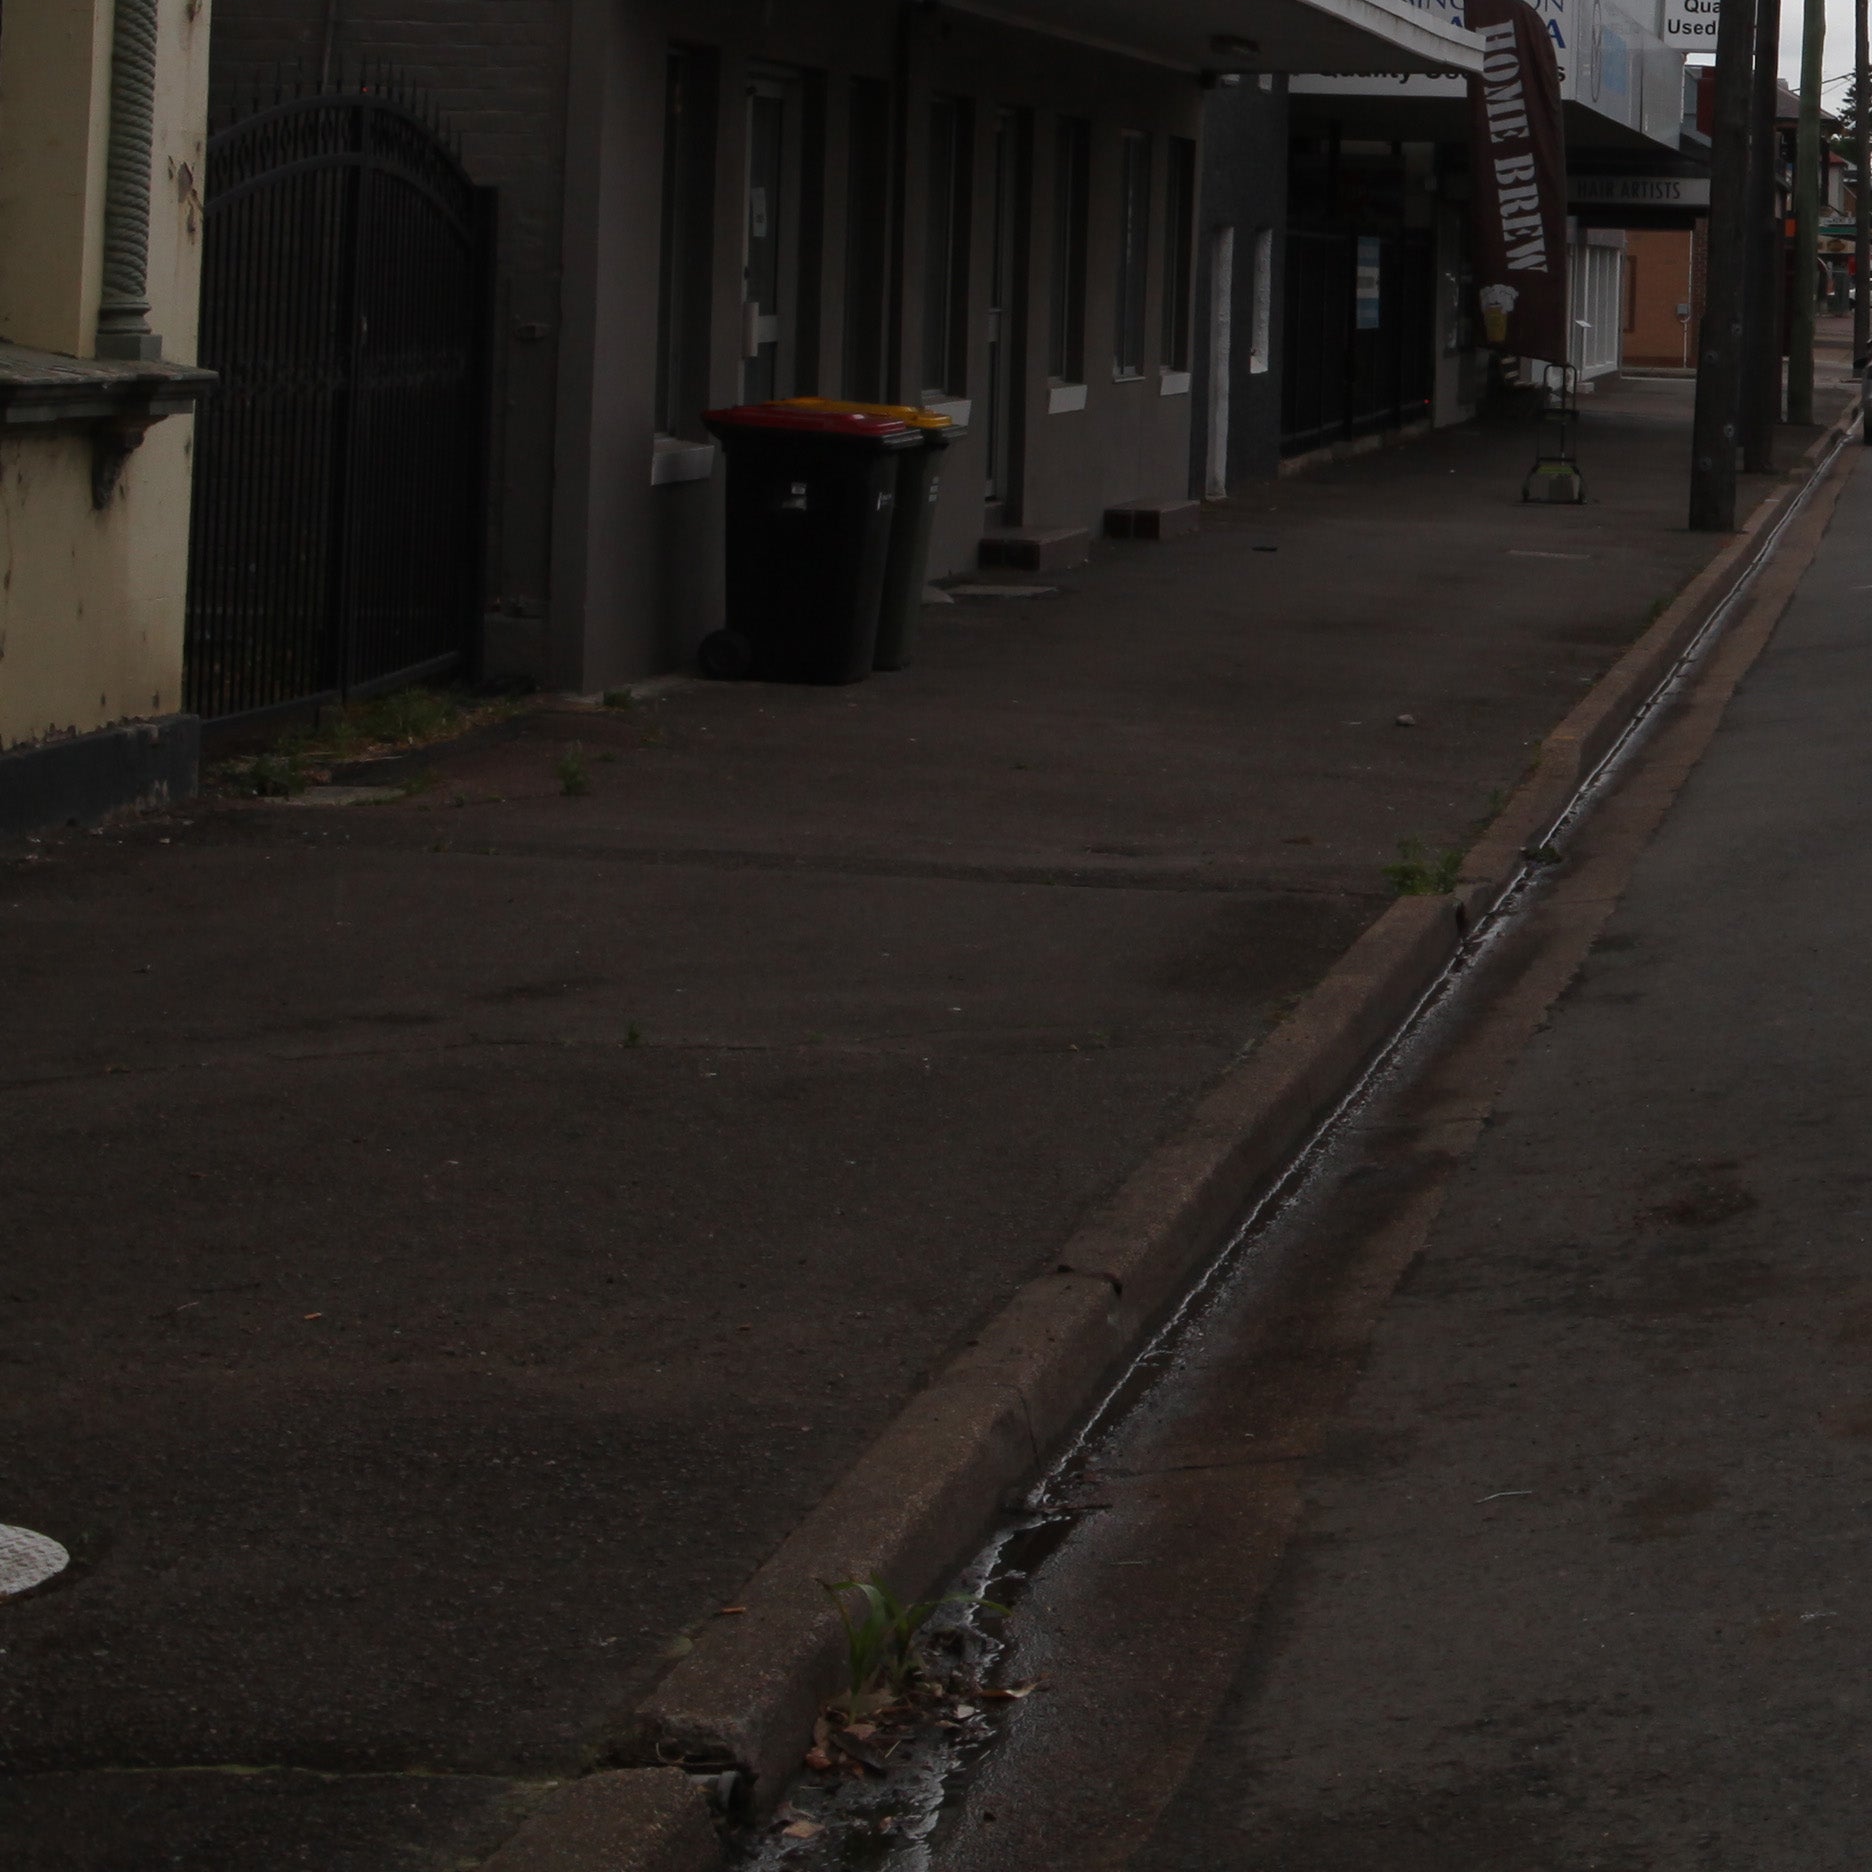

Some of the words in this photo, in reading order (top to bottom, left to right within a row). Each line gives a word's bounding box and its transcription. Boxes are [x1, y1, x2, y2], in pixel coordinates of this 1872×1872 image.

[1668, 19, 1716, 35] Used
[1475, 18, 1531, 144] HOME
[1493, 152, 1549, 273] BREW
[1577, 180, 1614, 199] HAIR
[1620, 181, 1681, 200] ARTISTS
